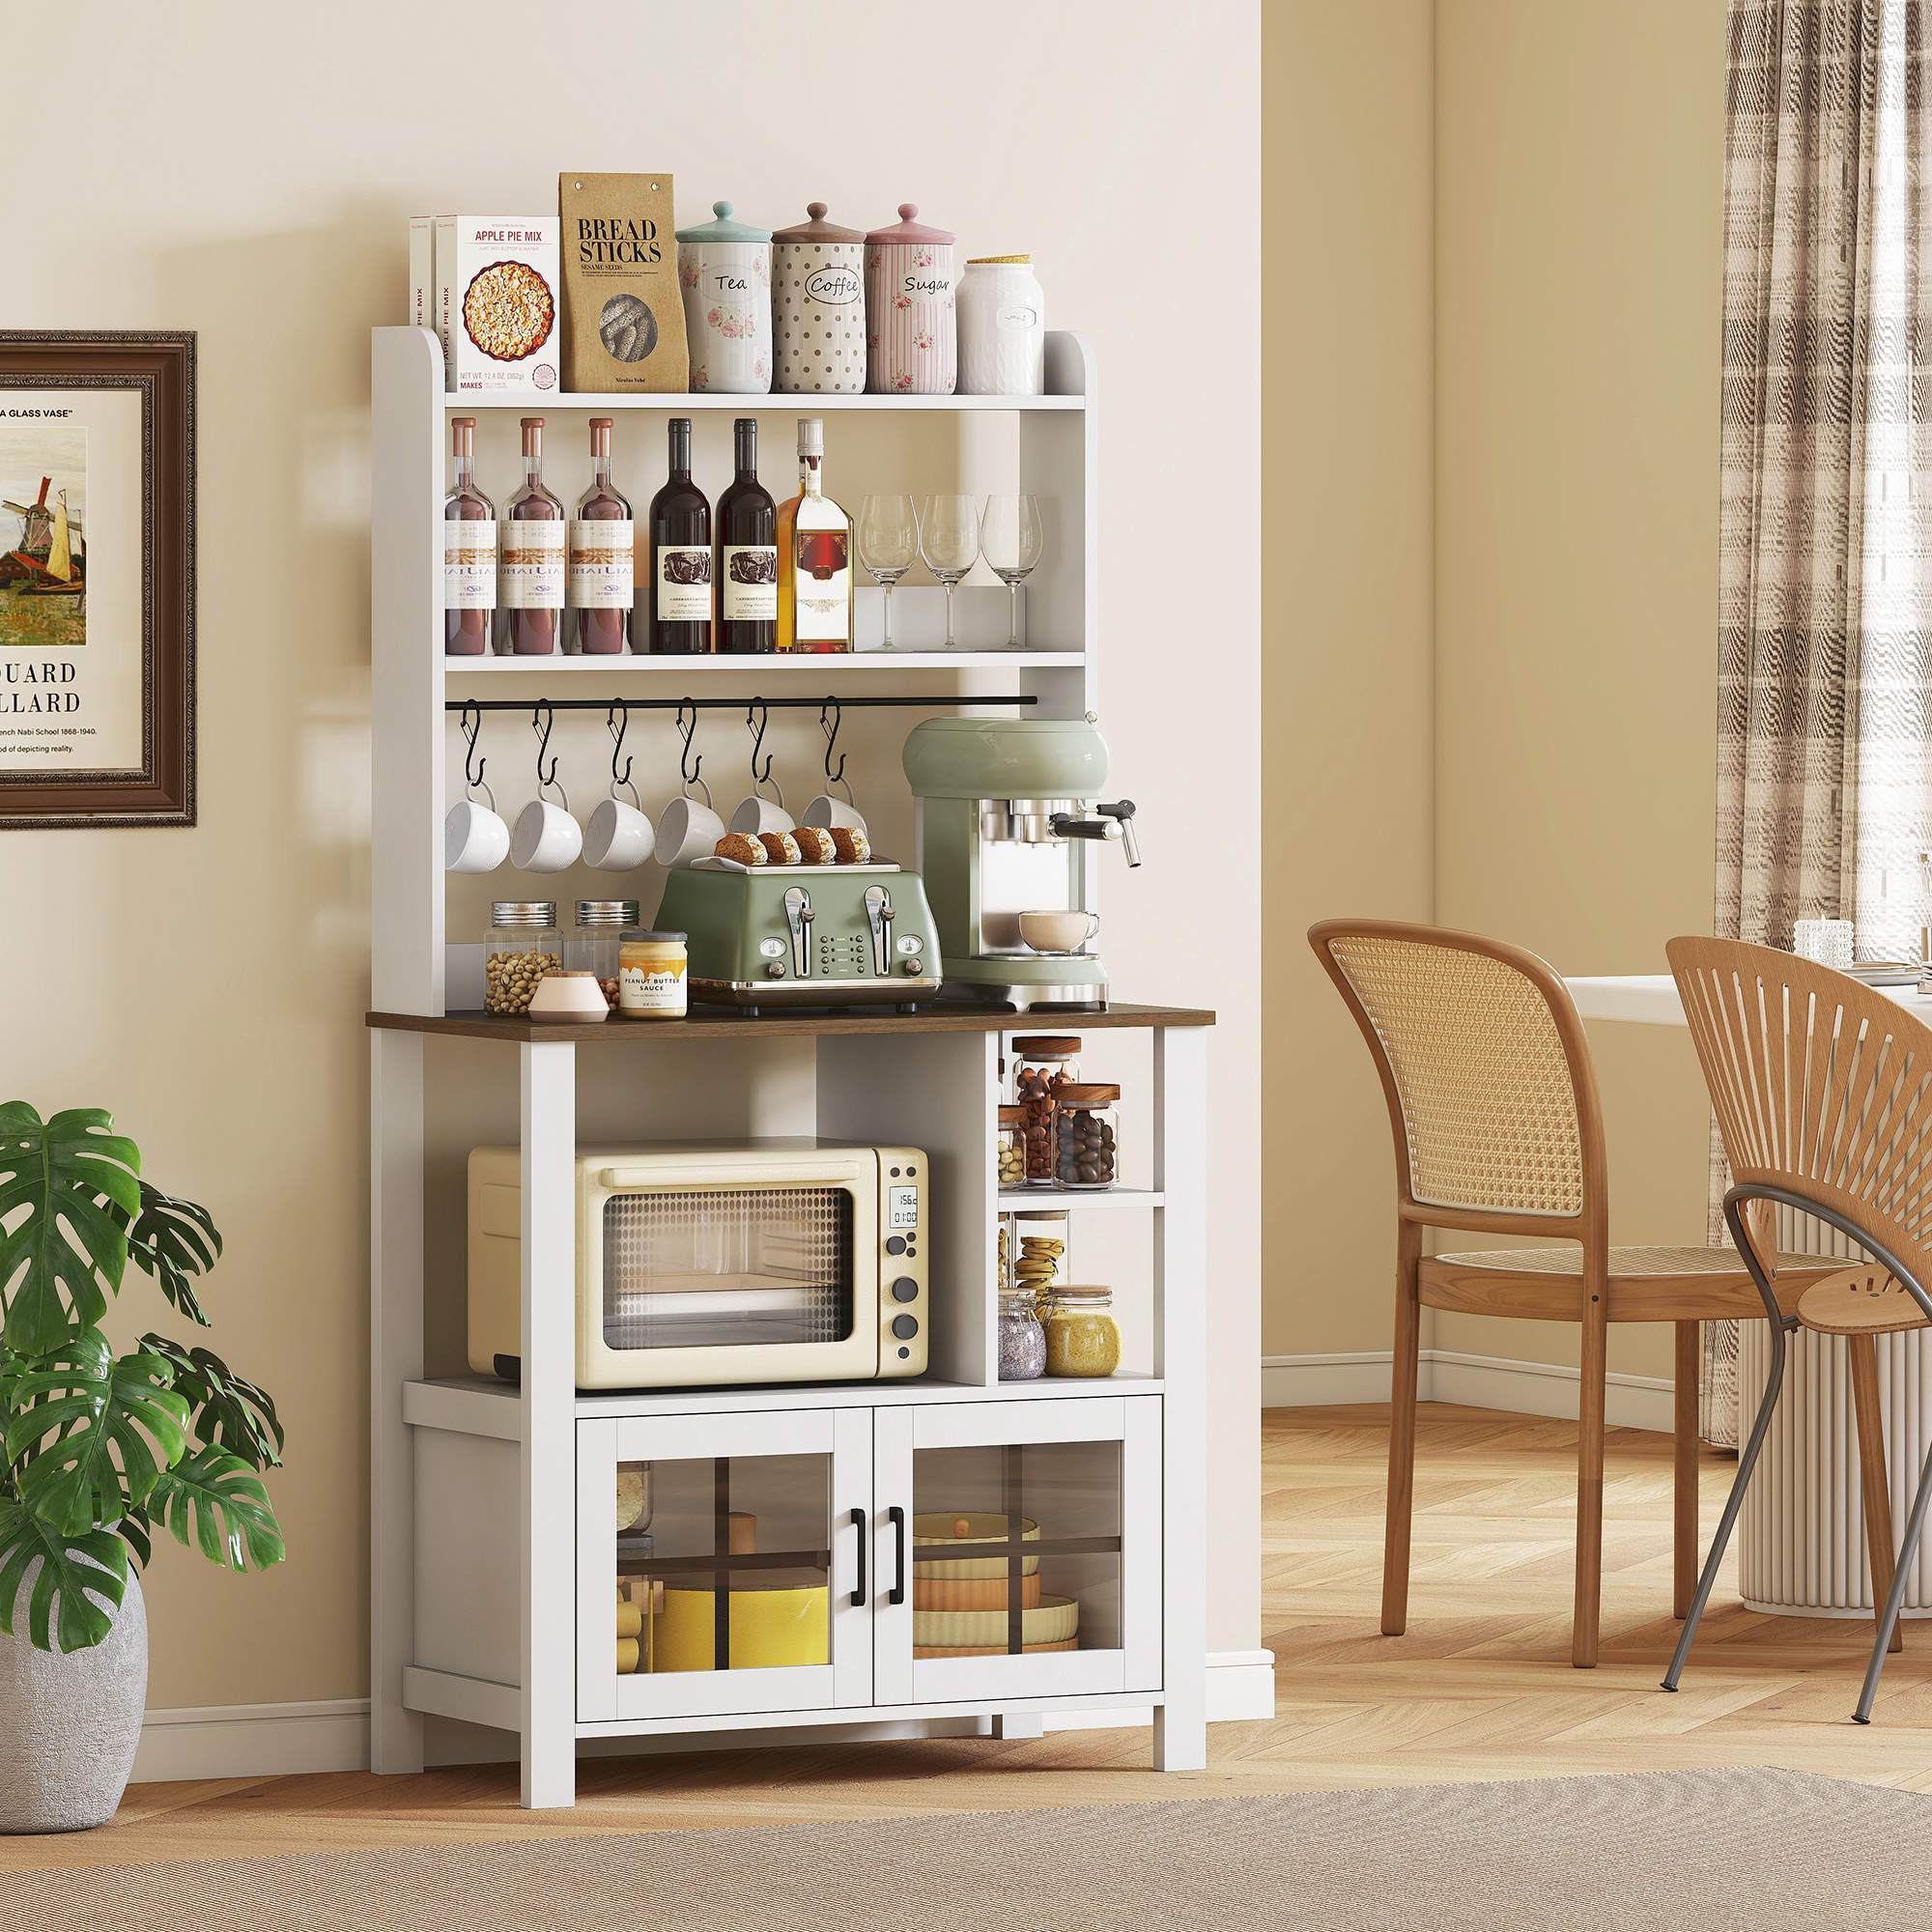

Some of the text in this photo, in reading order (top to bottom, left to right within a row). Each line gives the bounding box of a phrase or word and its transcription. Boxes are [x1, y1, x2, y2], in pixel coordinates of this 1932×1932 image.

[475, 230, 542, 242] APPLE PIE MIX
[577, 218, 657, 241] BREAD
[580, 241, 662, 263] STICKS
[715, 275, 748, 291] Tea
[810, 277, 859, 296] Coffee
[904, 276, 951, 296] Sugar
[0, 663, 75, 683] UARD
[51, 745, 74, 753] reality.
[895, 1212, 918, 1223] 01:00
